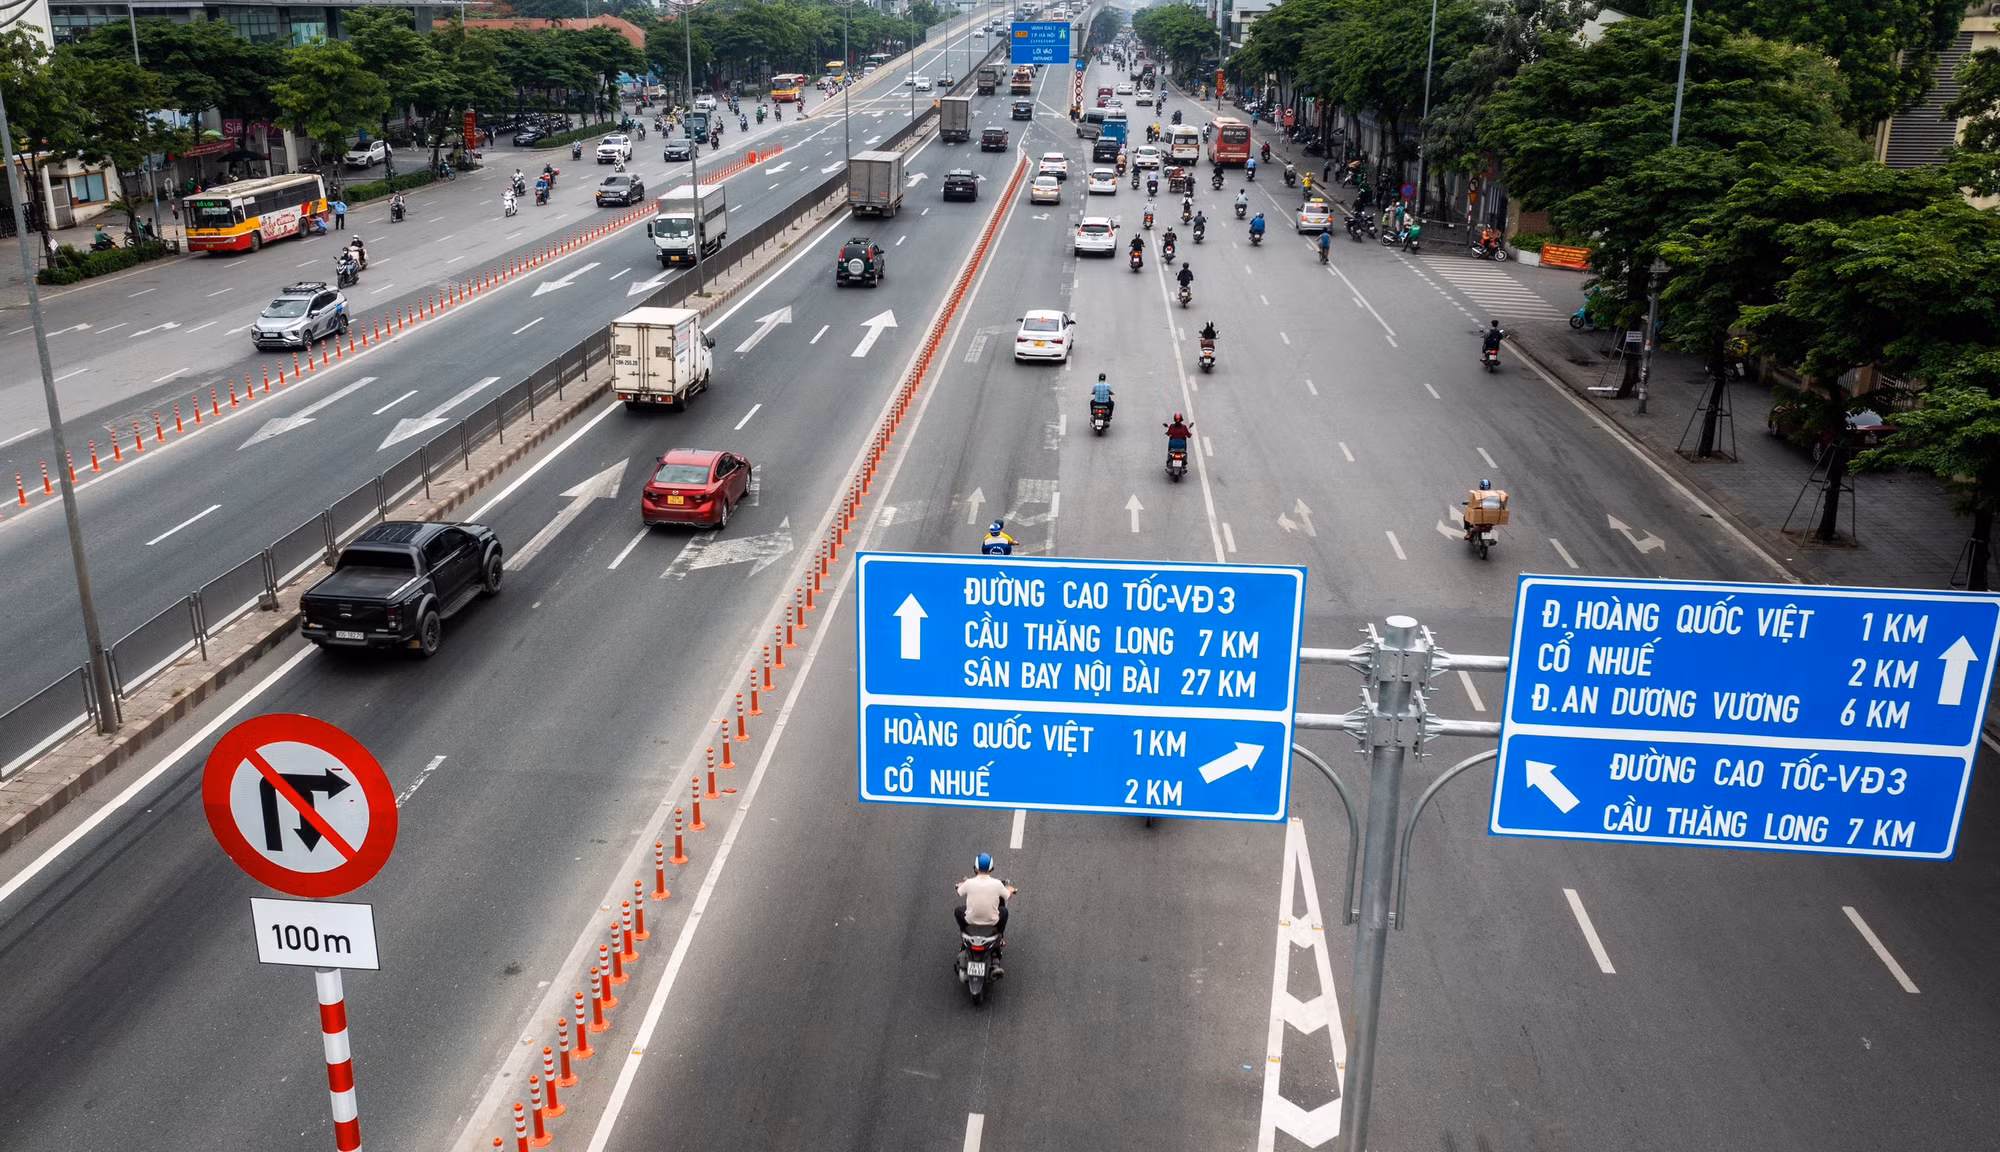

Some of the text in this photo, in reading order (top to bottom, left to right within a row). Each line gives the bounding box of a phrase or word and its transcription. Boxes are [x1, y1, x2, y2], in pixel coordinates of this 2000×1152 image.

[964, 572, 1044, 607] ĐƯỜNG
[1064, 581, 1108, 609] CAO
[966, 612, 1258, 658] CẦU THĂNG LONG 7 KM
[1677, 595, 1743, 634] QUỐC
[1758, 604, 1814, 643] VIỆT
[1883, 614, 1928, 643] KM
[965, 656, 1256, 697] SÂN BAY NỘI BÀI 27 KM
[1538, 632, 1918, 688] CỔ NHUẾ 2 KM
[1612, 687, 1696, 717] DƯƠNG
[1714, 692, 1800, 723] VƯƠNG
[1841, 699, 1856, 726] 6
[1867, 700, 1910, 728] KM
[885, 713, 957, 747] HOÀNG
[974, 714, 1031, 750] QUỐC
[1043, 720, 1094, 757] VIỆT
[885, 756, 1182, 806] CỔ NHUẾ 2 KM
[1610, 748, 1696, 783] ĐƯỜNG
[1714, 759, 1764, 787] CAO
[1604, 796, 1915, 847] CẦU THĂNG LONG 7 KM
[272, 924, 351, 953] 100m
